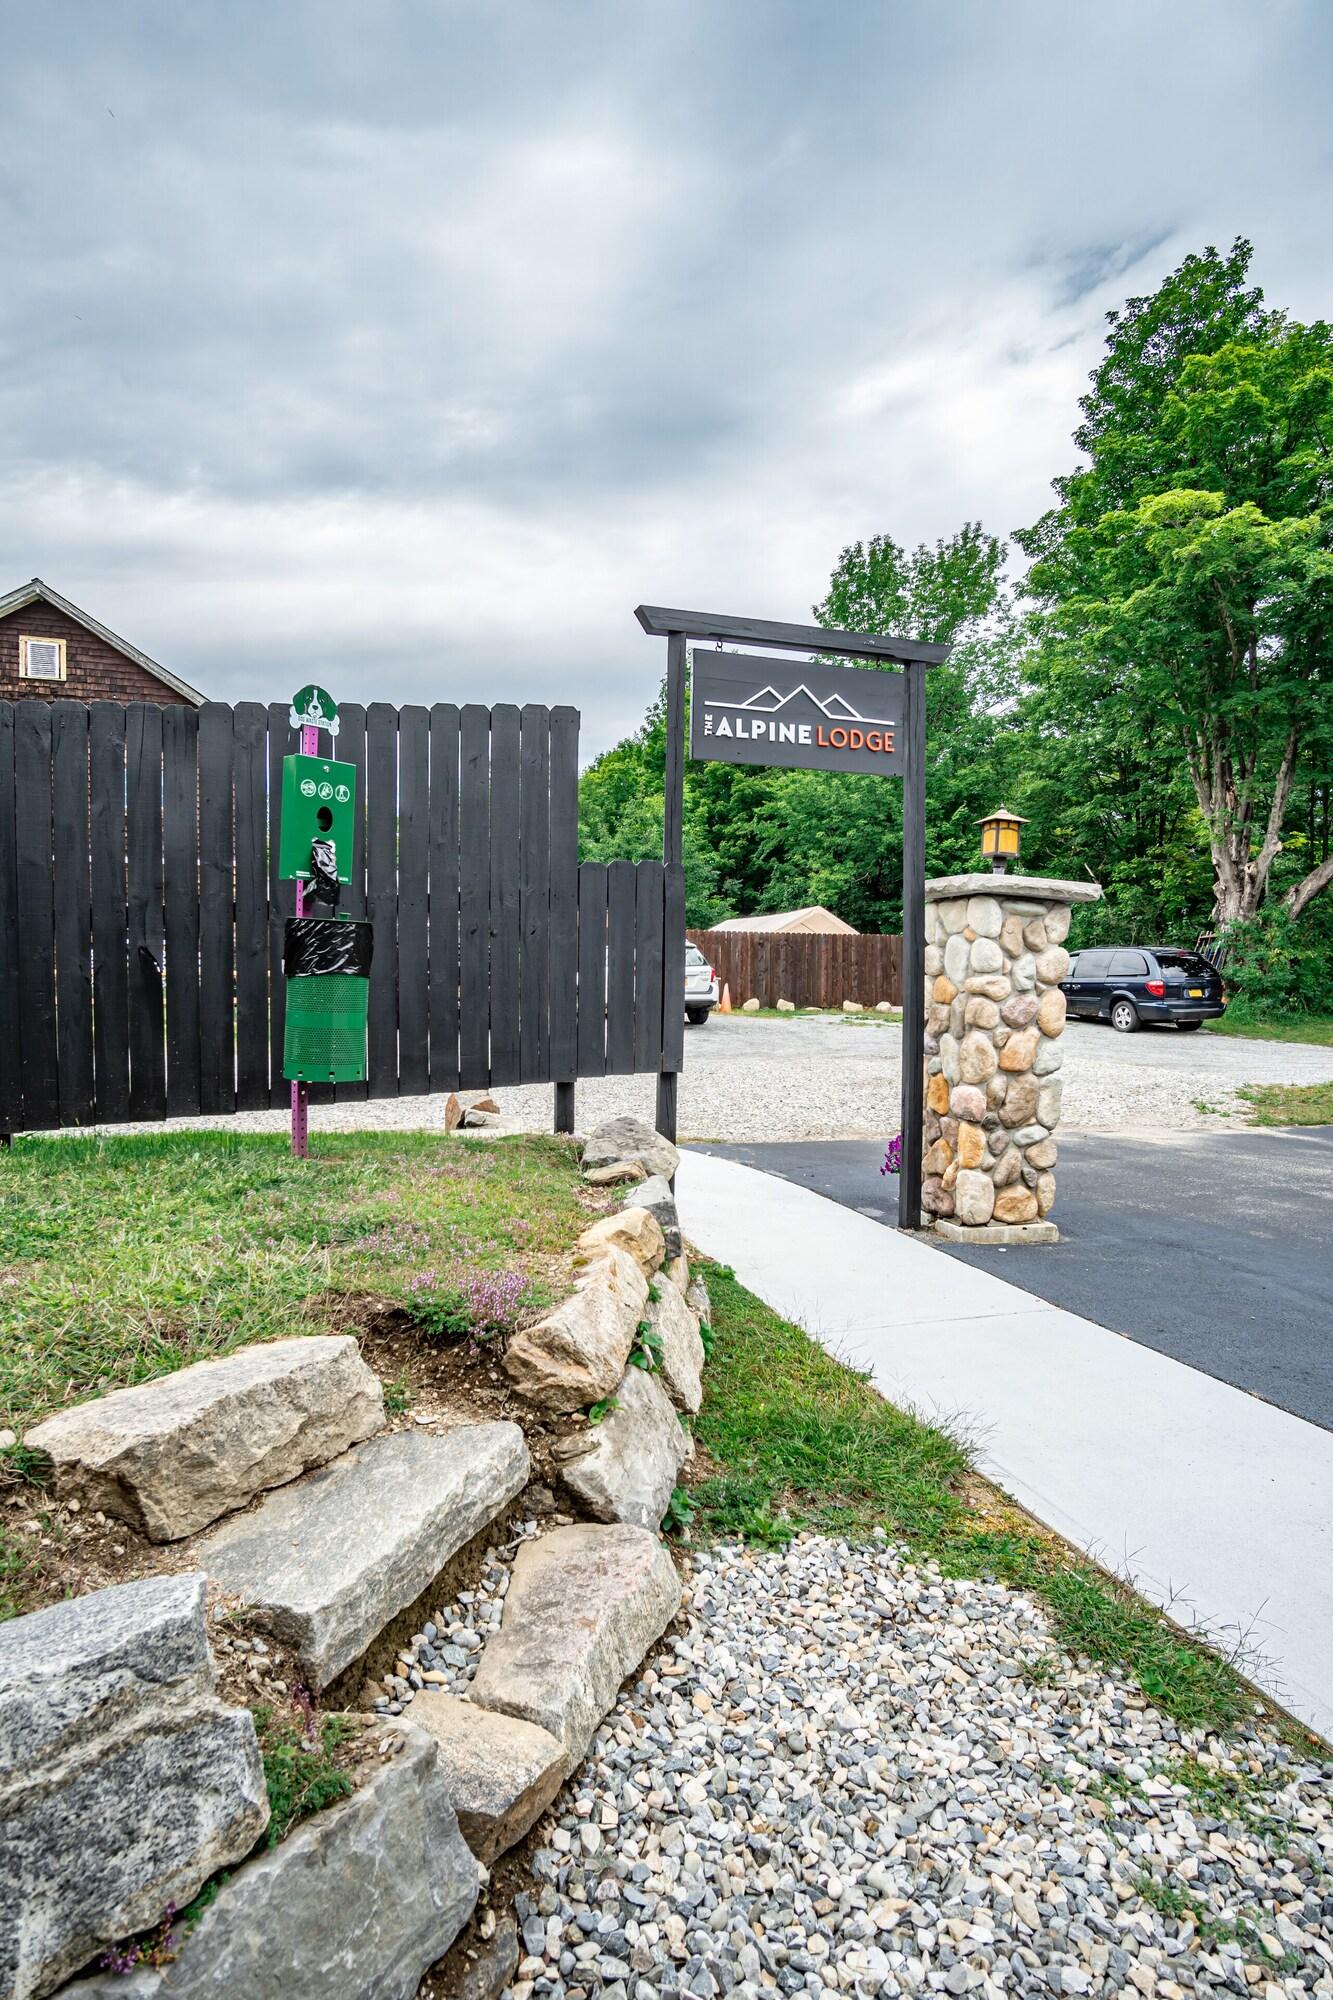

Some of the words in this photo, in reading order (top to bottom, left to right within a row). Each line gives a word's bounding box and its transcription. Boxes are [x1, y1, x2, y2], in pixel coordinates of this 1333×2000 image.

[704, 714, 713, 736] THE
[715, 716, 812, 745] ALPINE
[816, 725, 896, 752] LODGE
